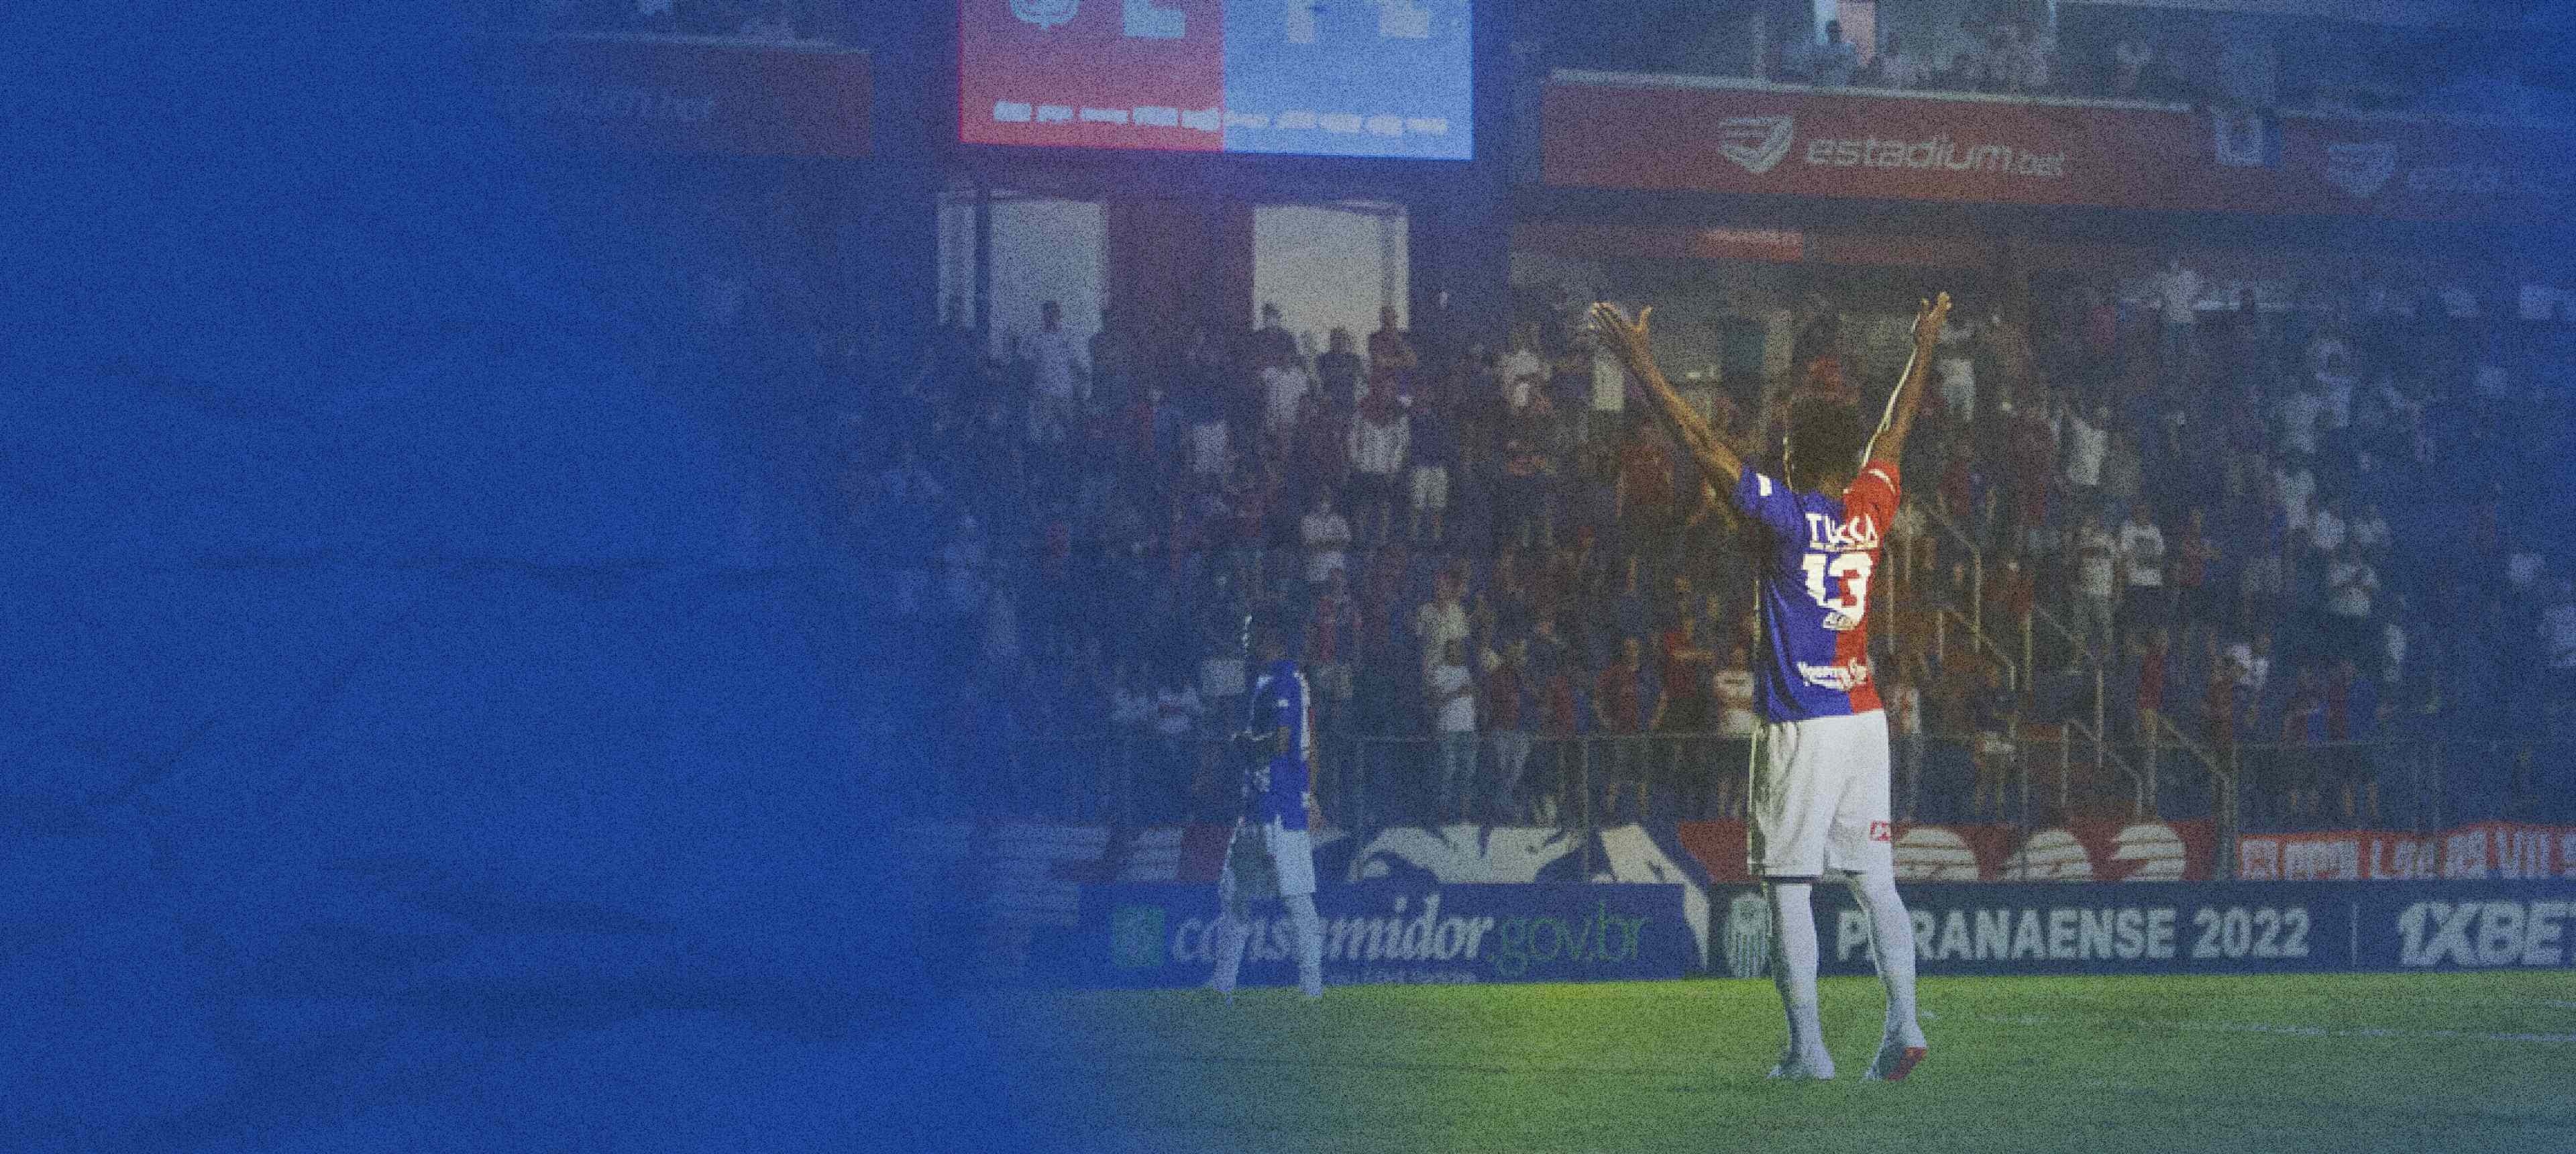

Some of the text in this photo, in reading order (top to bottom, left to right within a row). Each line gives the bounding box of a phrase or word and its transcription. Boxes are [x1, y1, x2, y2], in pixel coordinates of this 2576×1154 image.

[1807, 133, 2065, 179] estadium.bet
[1801, 552, 1873, 627] 13
[1171, 893, 1651, 977] consmidor.gov.br
[1837, 905, 2310, 961] PRANAENSE 2022
